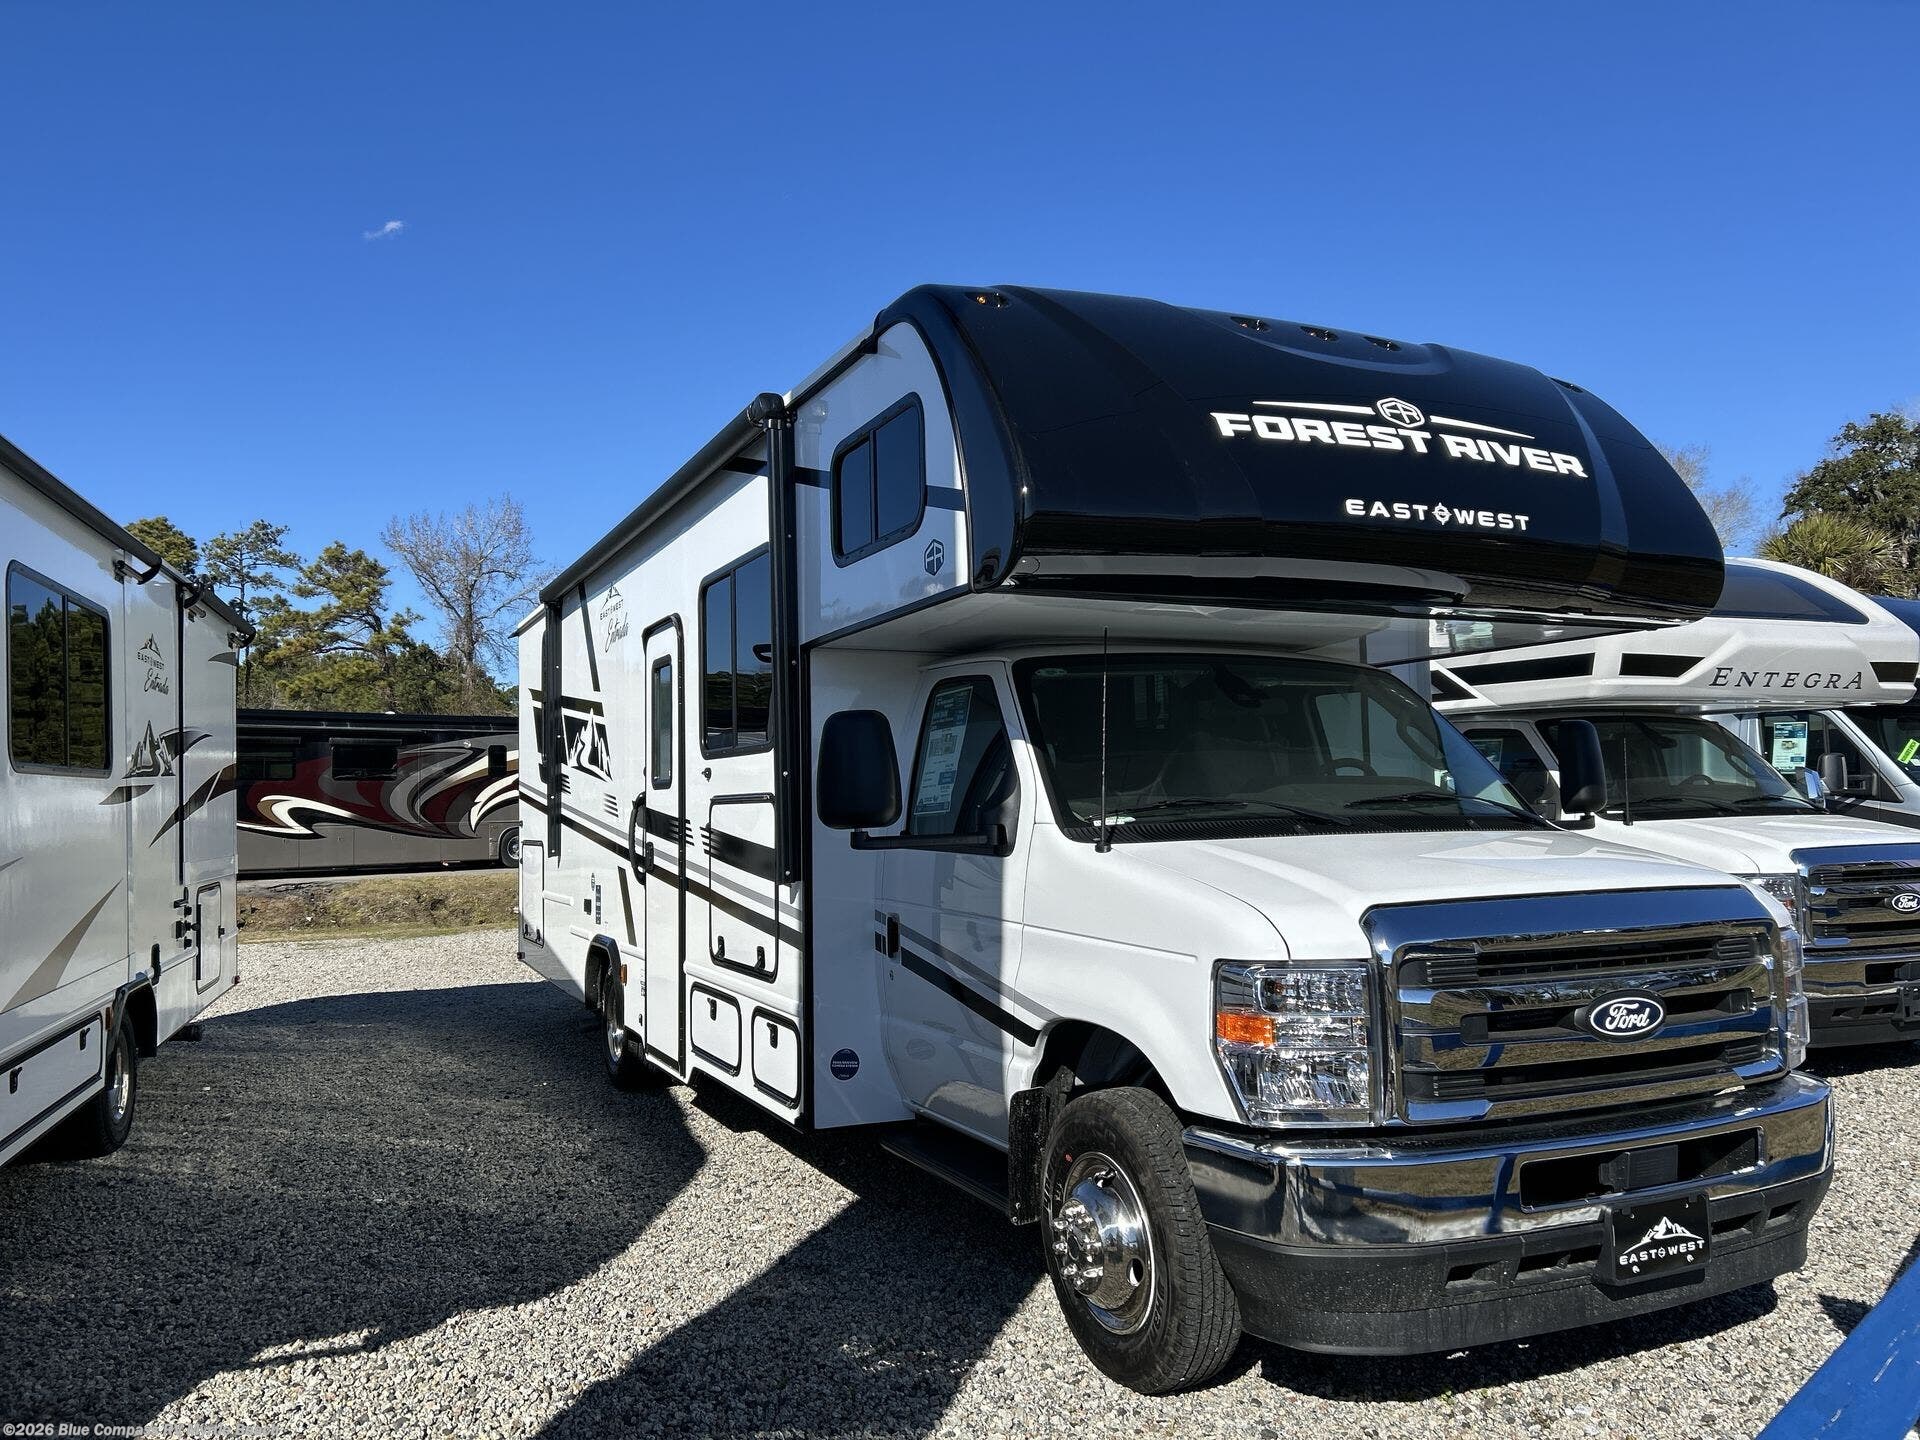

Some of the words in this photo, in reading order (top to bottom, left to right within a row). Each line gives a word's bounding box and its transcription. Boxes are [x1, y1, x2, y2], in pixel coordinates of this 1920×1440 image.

[1209, 412, 1432, 453] FOREST
[1438, 433, 1589, 478] RIVER
[1345, 499, 1428, 521] EAST
[1453, 508, 1530, 531] WEST
[1709, 667, 1863, 690] ENTEGRA
[1898, 896, 1919, 908] Ford
[1605, 1003, 1651, 1030] Ford
[1619, 1249, 1658, 1266] EAST
[1667, 1239, 1705, 1256] WEST
